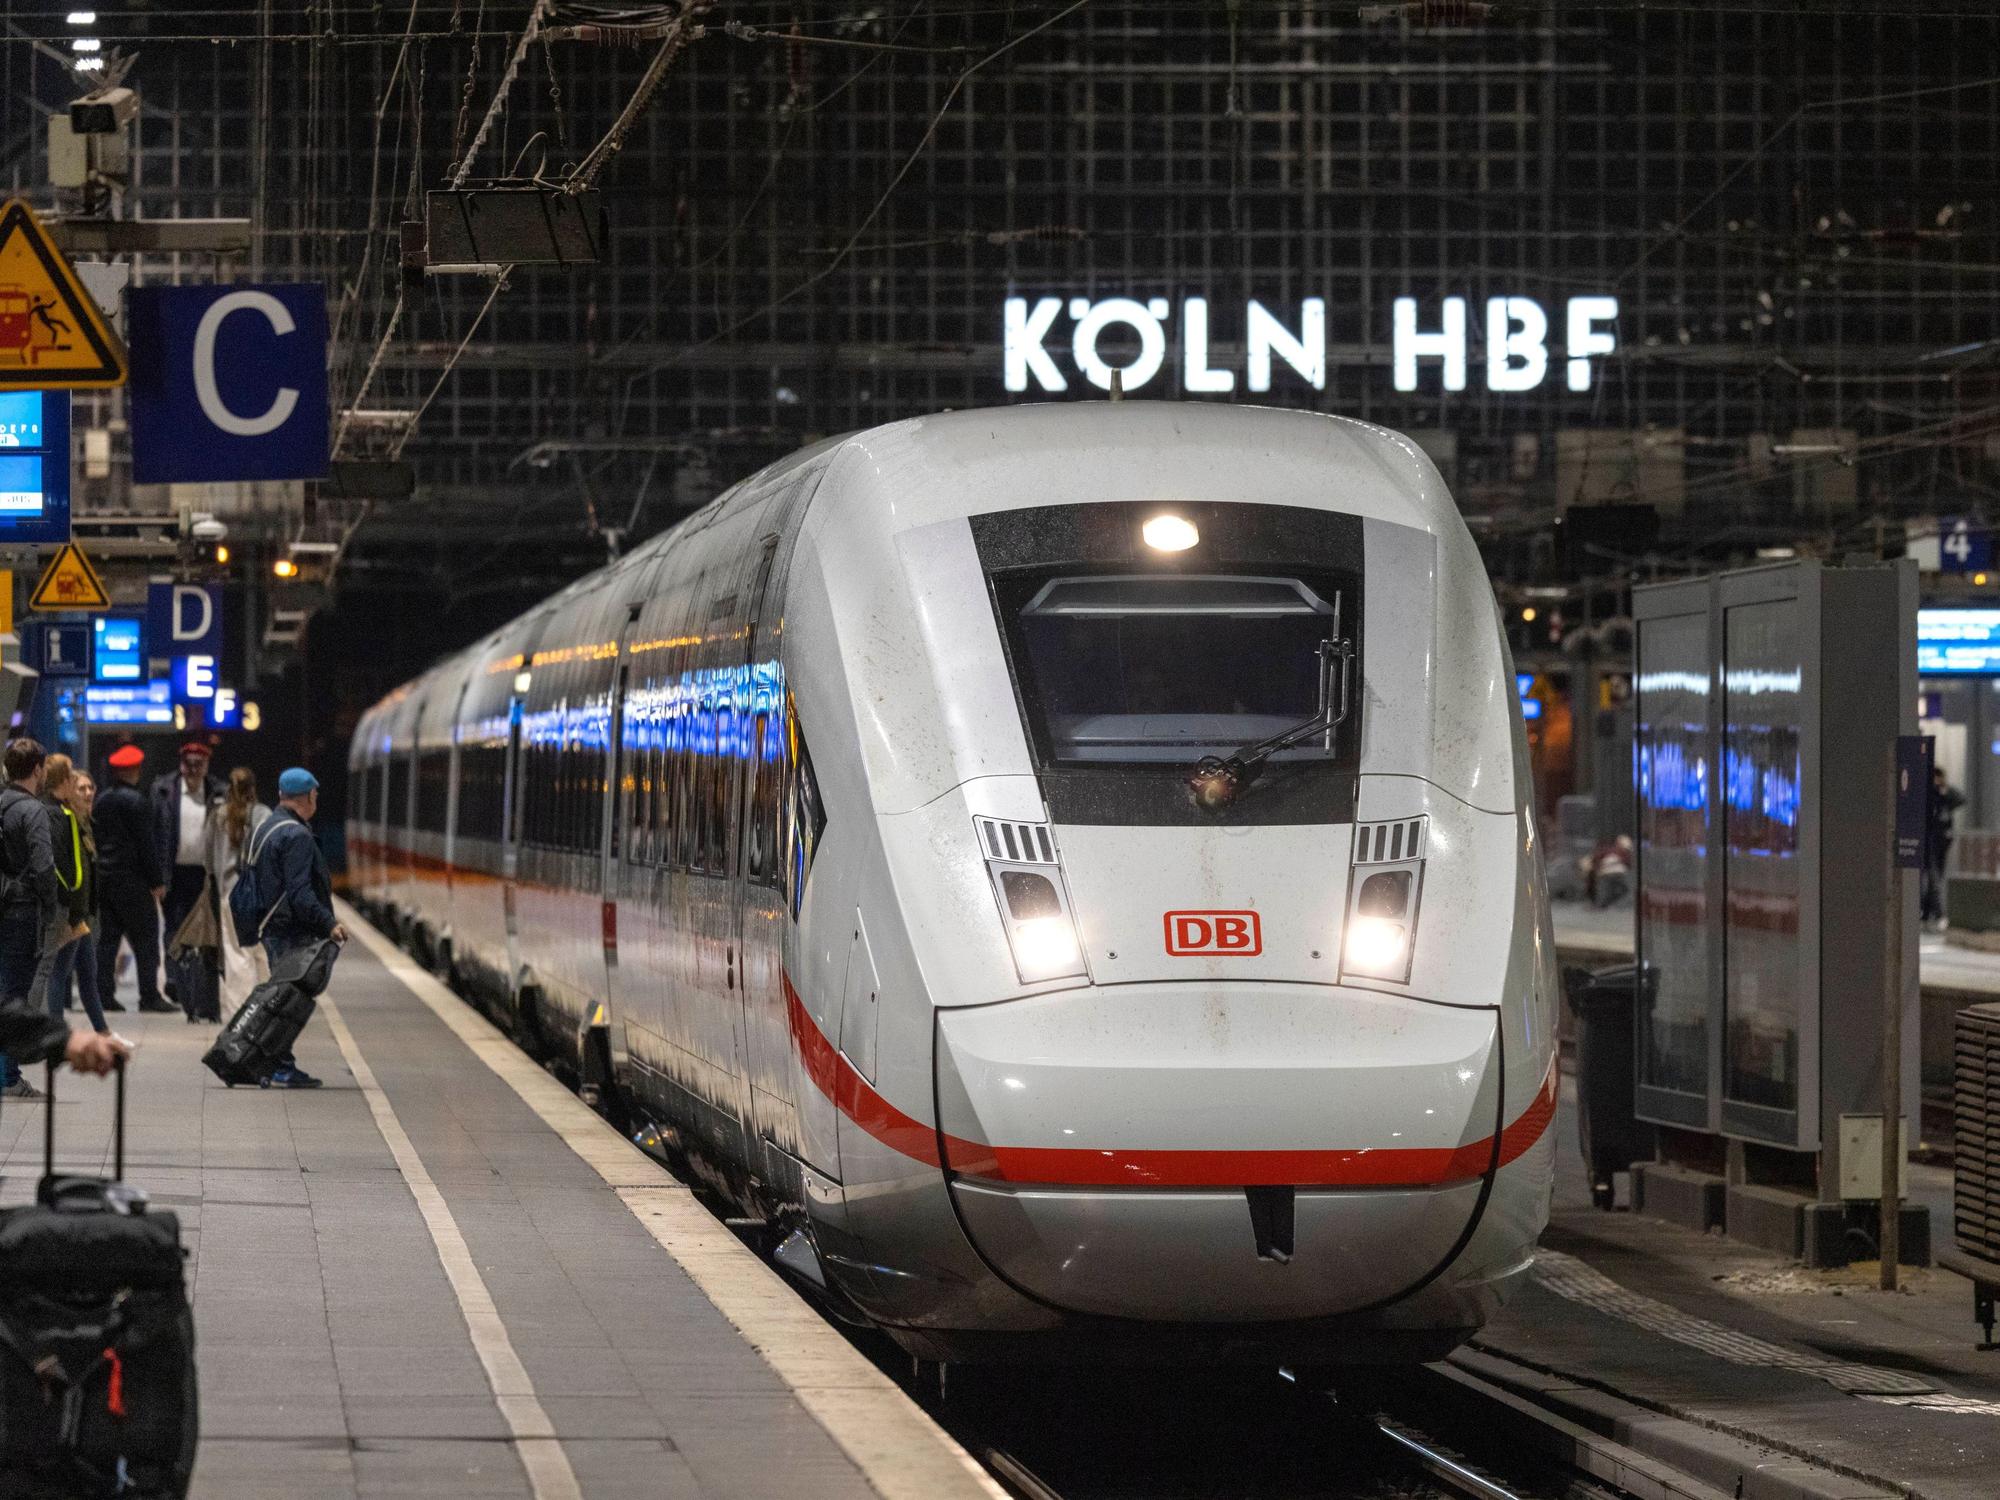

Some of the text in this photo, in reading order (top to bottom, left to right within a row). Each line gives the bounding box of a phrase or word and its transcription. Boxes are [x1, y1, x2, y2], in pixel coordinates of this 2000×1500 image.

[193, 290, 299, 436] C
[1004, 297, 1618, 392] KÖLN HBF
[1944, 519, 1972, 563] 4
[172, 586, 212, 641] D
[186, 655, 214, 698] E
[214, 688, 236, 723] F
[1176, 917, 1250, 949] DB
